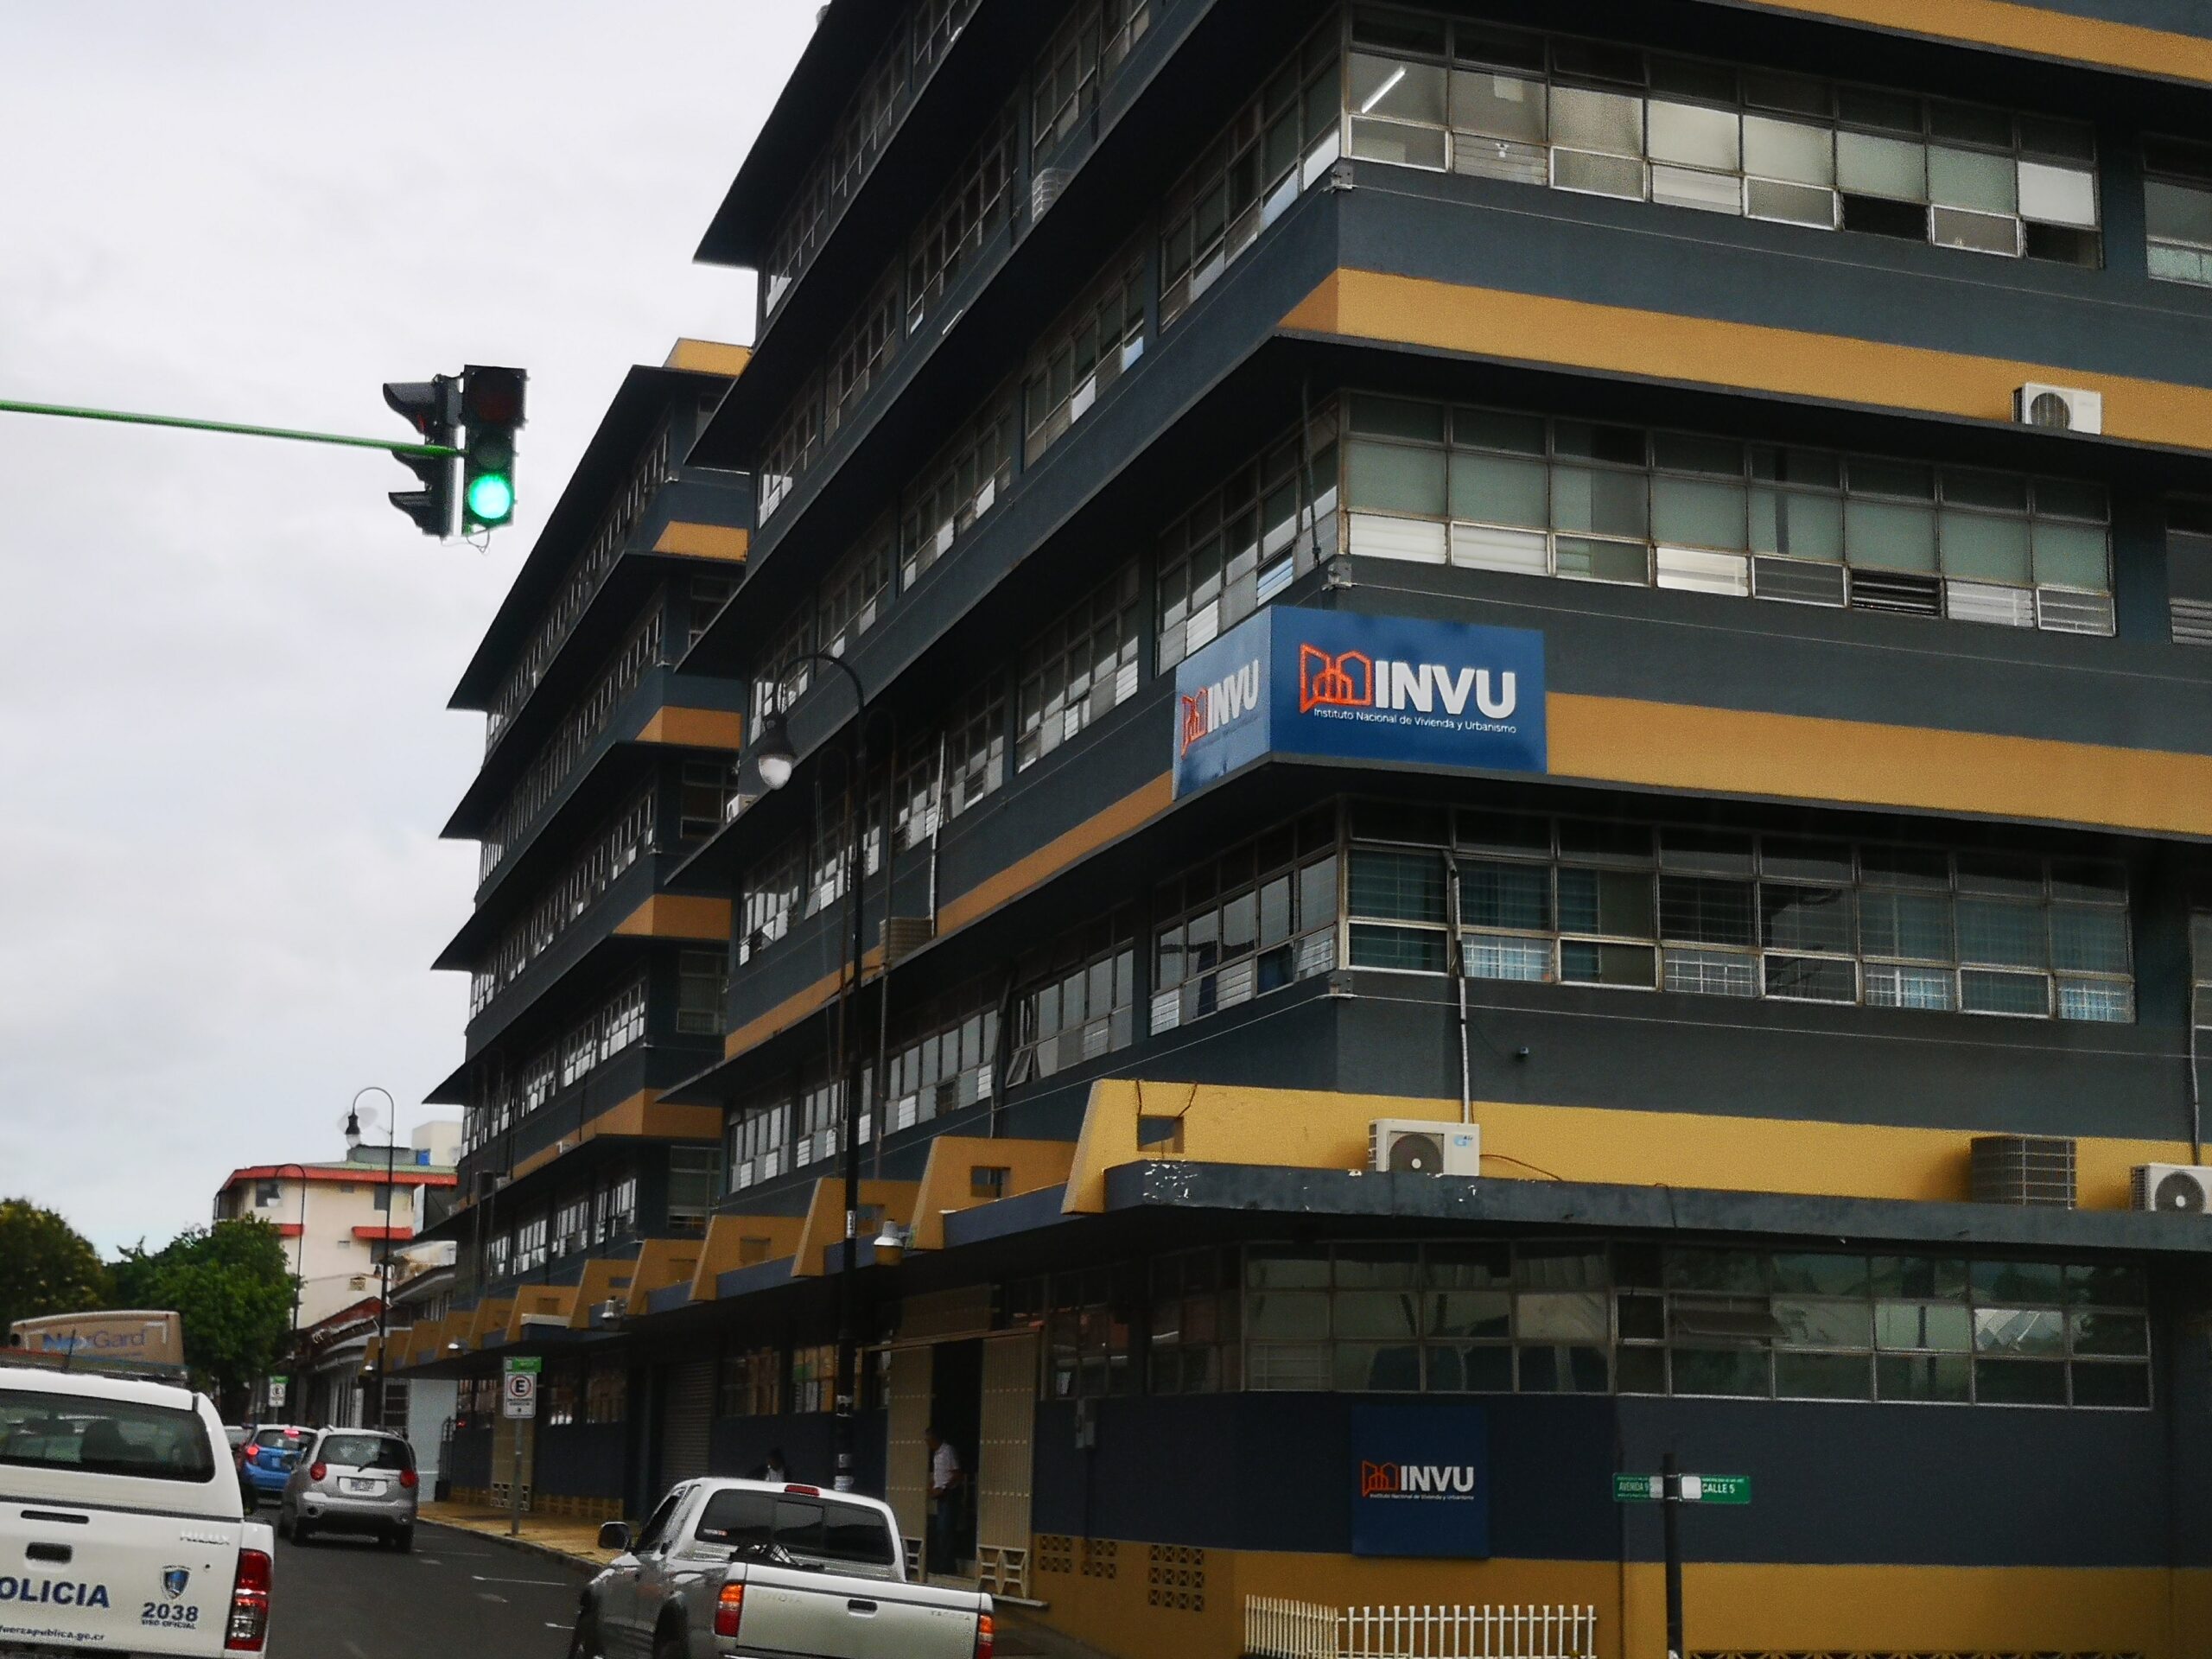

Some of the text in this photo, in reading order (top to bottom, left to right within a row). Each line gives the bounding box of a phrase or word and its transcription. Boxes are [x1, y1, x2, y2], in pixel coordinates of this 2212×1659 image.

[1207, 659, 1259, 734] INVU
[1375, 660, 1516, 719] INVU
[1313, 708, 1517, 734] Instituto Nacional de Vivienda y Urbanismo
[515, 1379, 526, 1393] E
[1401, 1465, 1474, 1493] INVU
[1618, 1481, 1644, 1492] AVENIDA
[1701, 1483, 1736, 1494] CALLE 5
[141, 1601, 199, 1623] 2038
